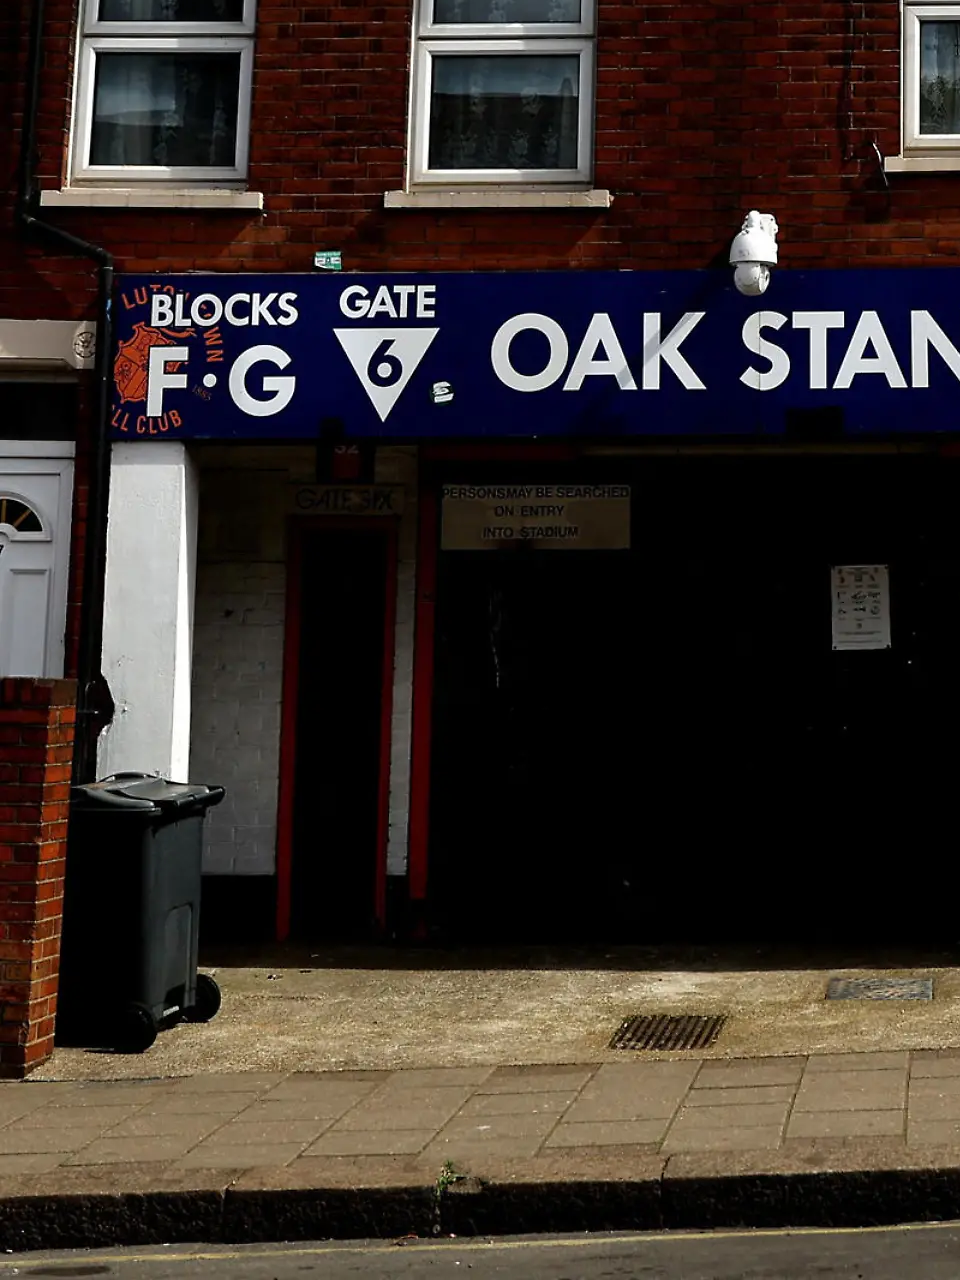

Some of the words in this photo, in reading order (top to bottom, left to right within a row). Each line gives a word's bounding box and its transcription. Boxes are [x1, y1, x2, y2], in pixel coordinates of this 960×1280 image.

[150, 291, 299, 327] BLOCKS
[339, 284, 437, 319] GATE
[367, 338, 403, 388] 6
[490, 311, 707, 393] OAK
[136, 409, 184, 434] CLUB
[536, 486, 552, 498] BE
[556, 486, 630, 498] SEARCHED
[494, 505, 514, 517] ON
[521, 505, 564, 517] ENTRY
[483, 527, 514, 538] INTO
[520, 526, 578, 538] STADIUM
